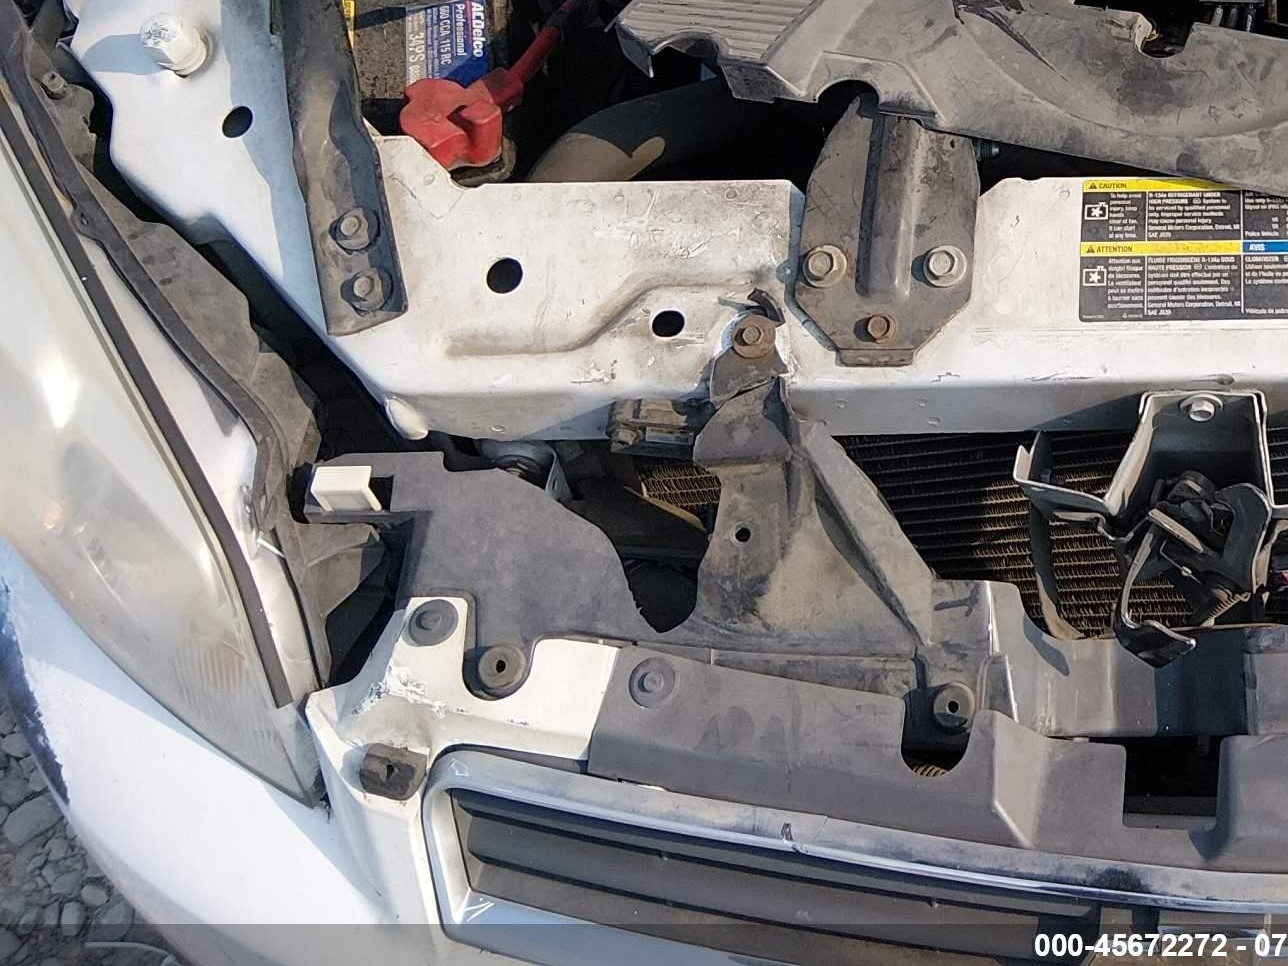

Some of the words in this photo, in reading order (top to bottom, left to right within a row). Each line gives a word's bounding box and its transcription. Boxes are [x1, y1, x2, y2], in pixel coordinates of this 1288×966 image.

[456, 4, 468, 56] Professional
[471, 2, 486, 57] ACDelco
[440, 40, 451, 52] 115
[441, 55, 451, 65] RC
